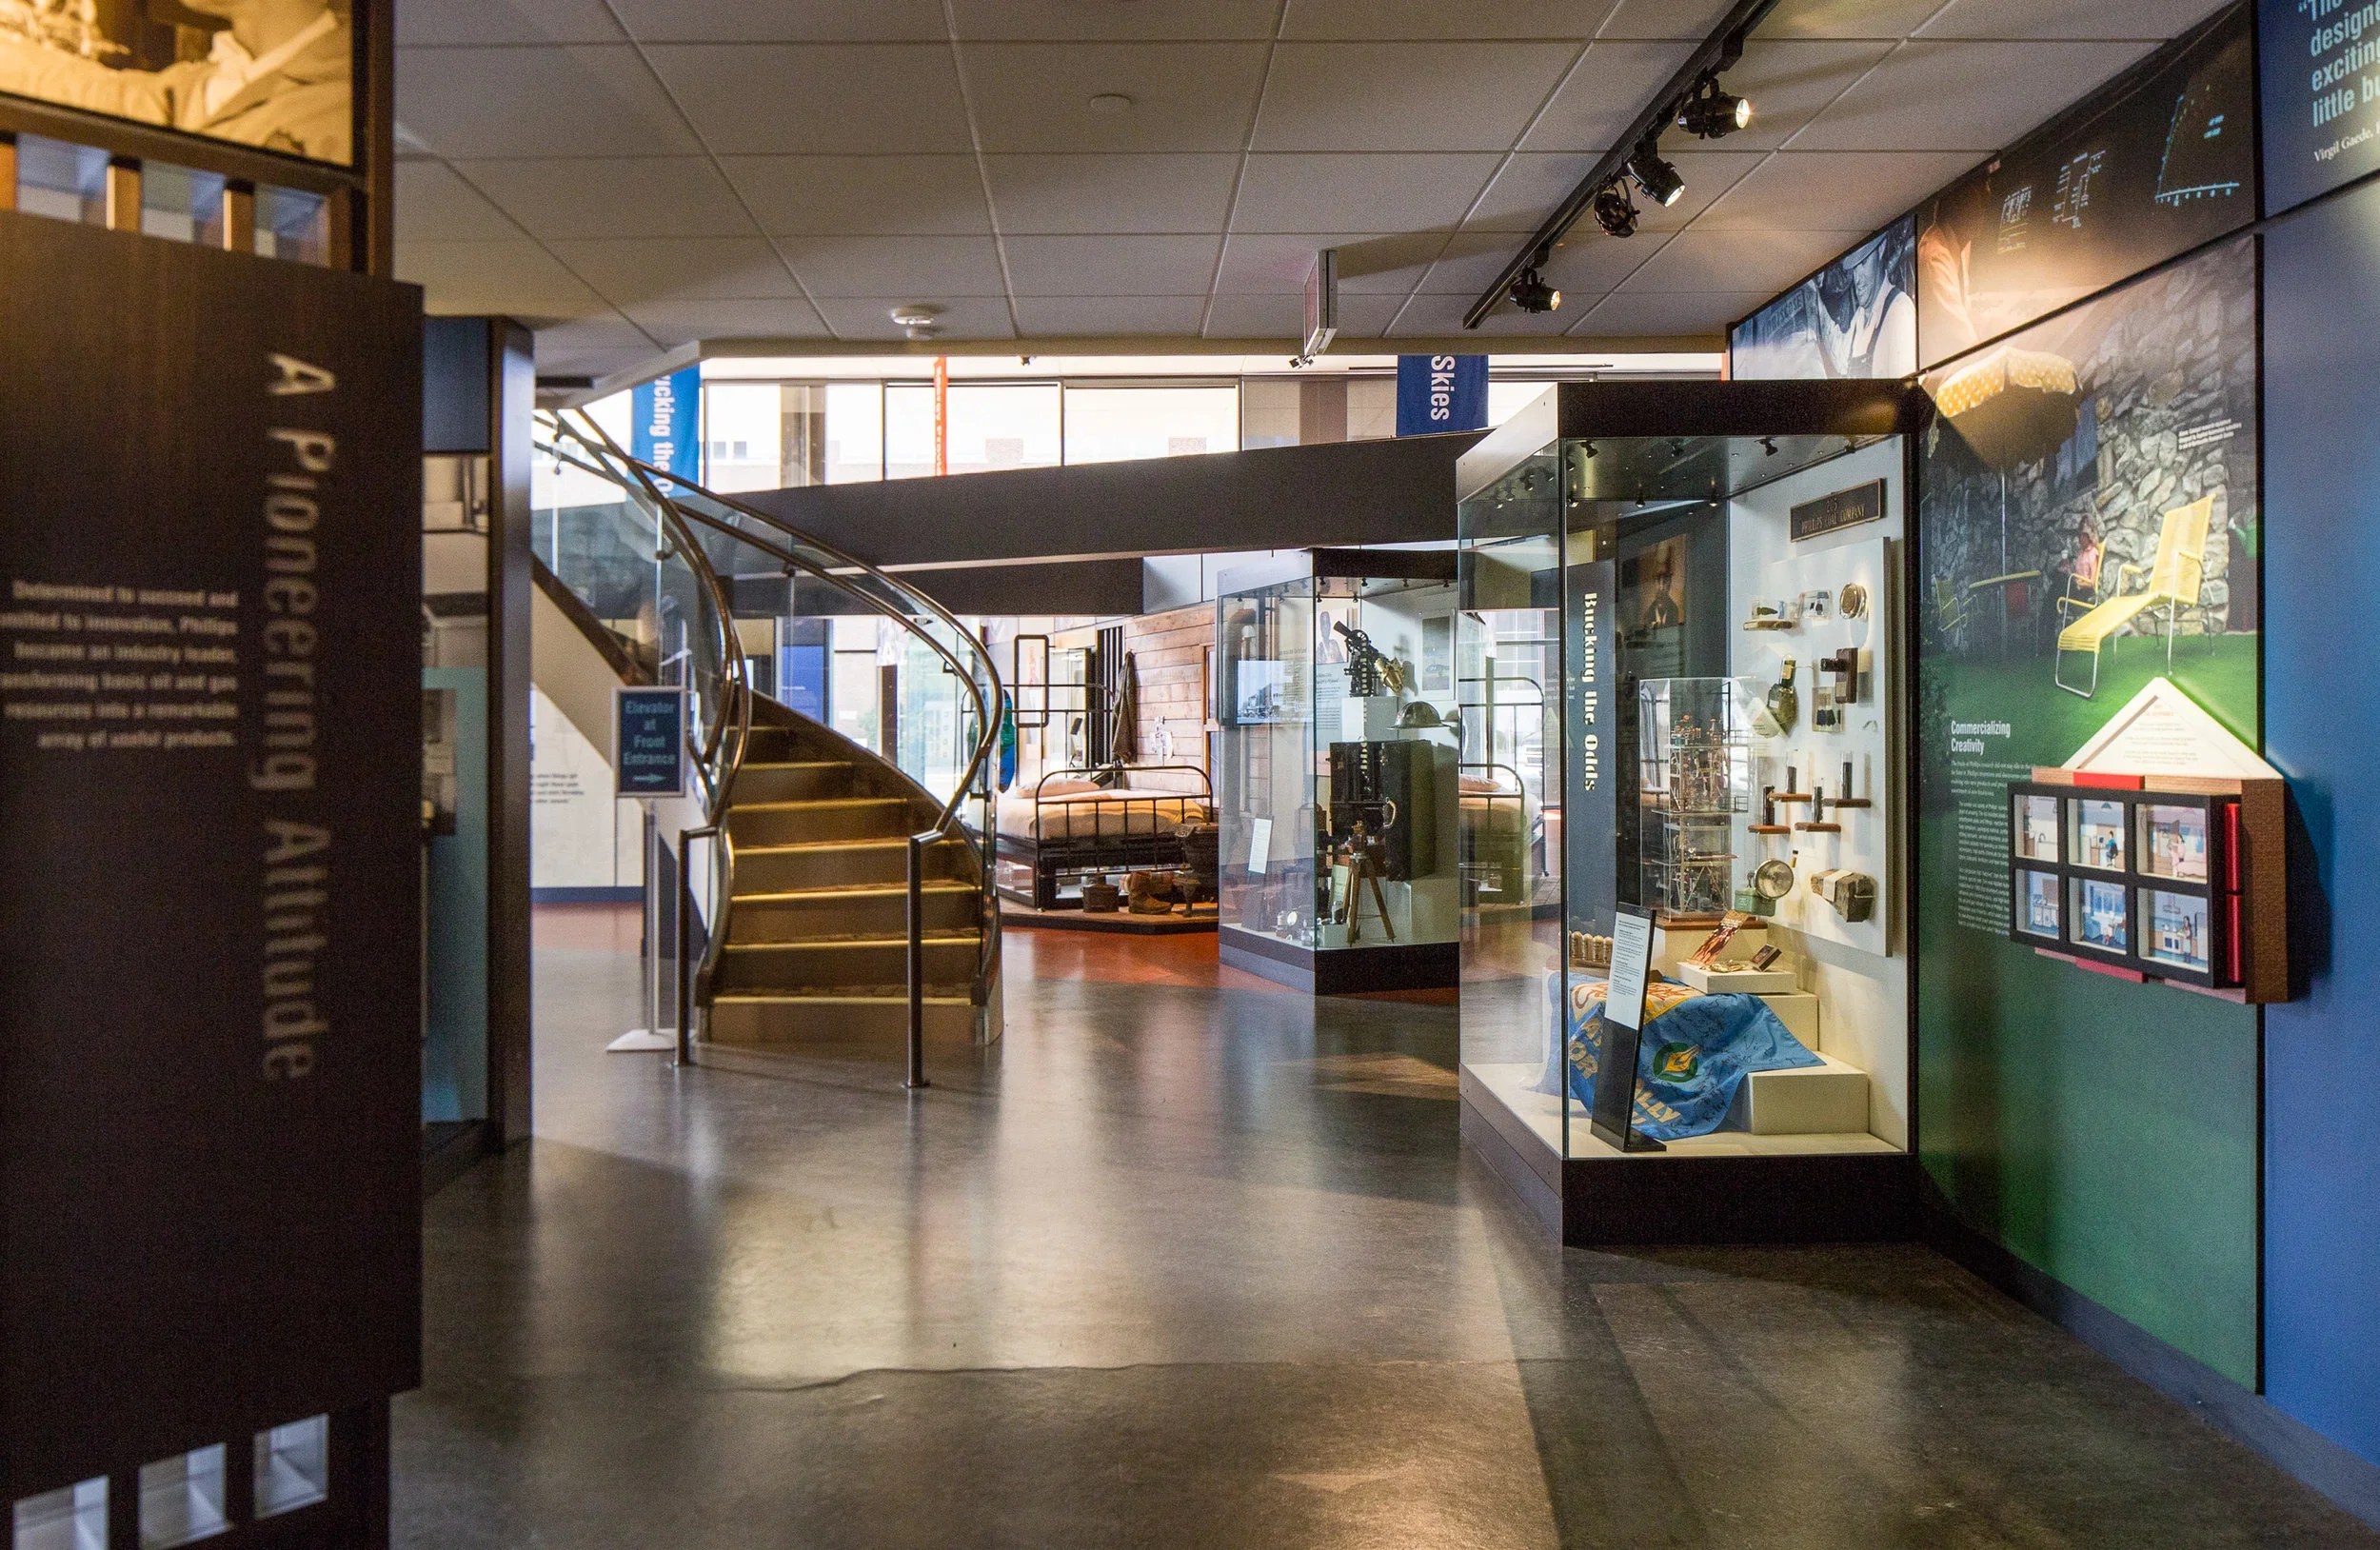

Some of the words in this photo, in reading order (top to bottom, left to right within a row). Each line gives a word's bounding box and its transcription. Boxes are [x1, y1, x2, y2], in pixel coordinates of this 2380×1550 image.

[2312, 88, 2355, 128] little
[2313, 141, 2340, 162] Virgil
[269, 351, 335, 396] A
[1431, 355, 1456, 420] Skies
[652, 442, 674, 472] the
[1840, 503, 1866, 523] COMPANY
[249, 426, 335, 790] Pioneering
[1581, 592, 1597, 683] Bucking
[625, 700, 675, 714] Elevator
[1584, 691, 1597, 725] the
[644, 719, 656, 730] at
[1951, 720, 2011, 739] Commercializing
[633, 734, 665, 748] Front
[1951, 738, 1985, 756] Creativity
[623, 751, 676, 765] Entrance
[1584, 734, 1598, 791] Odds
[262, 818, 331, 1081] Attitude
